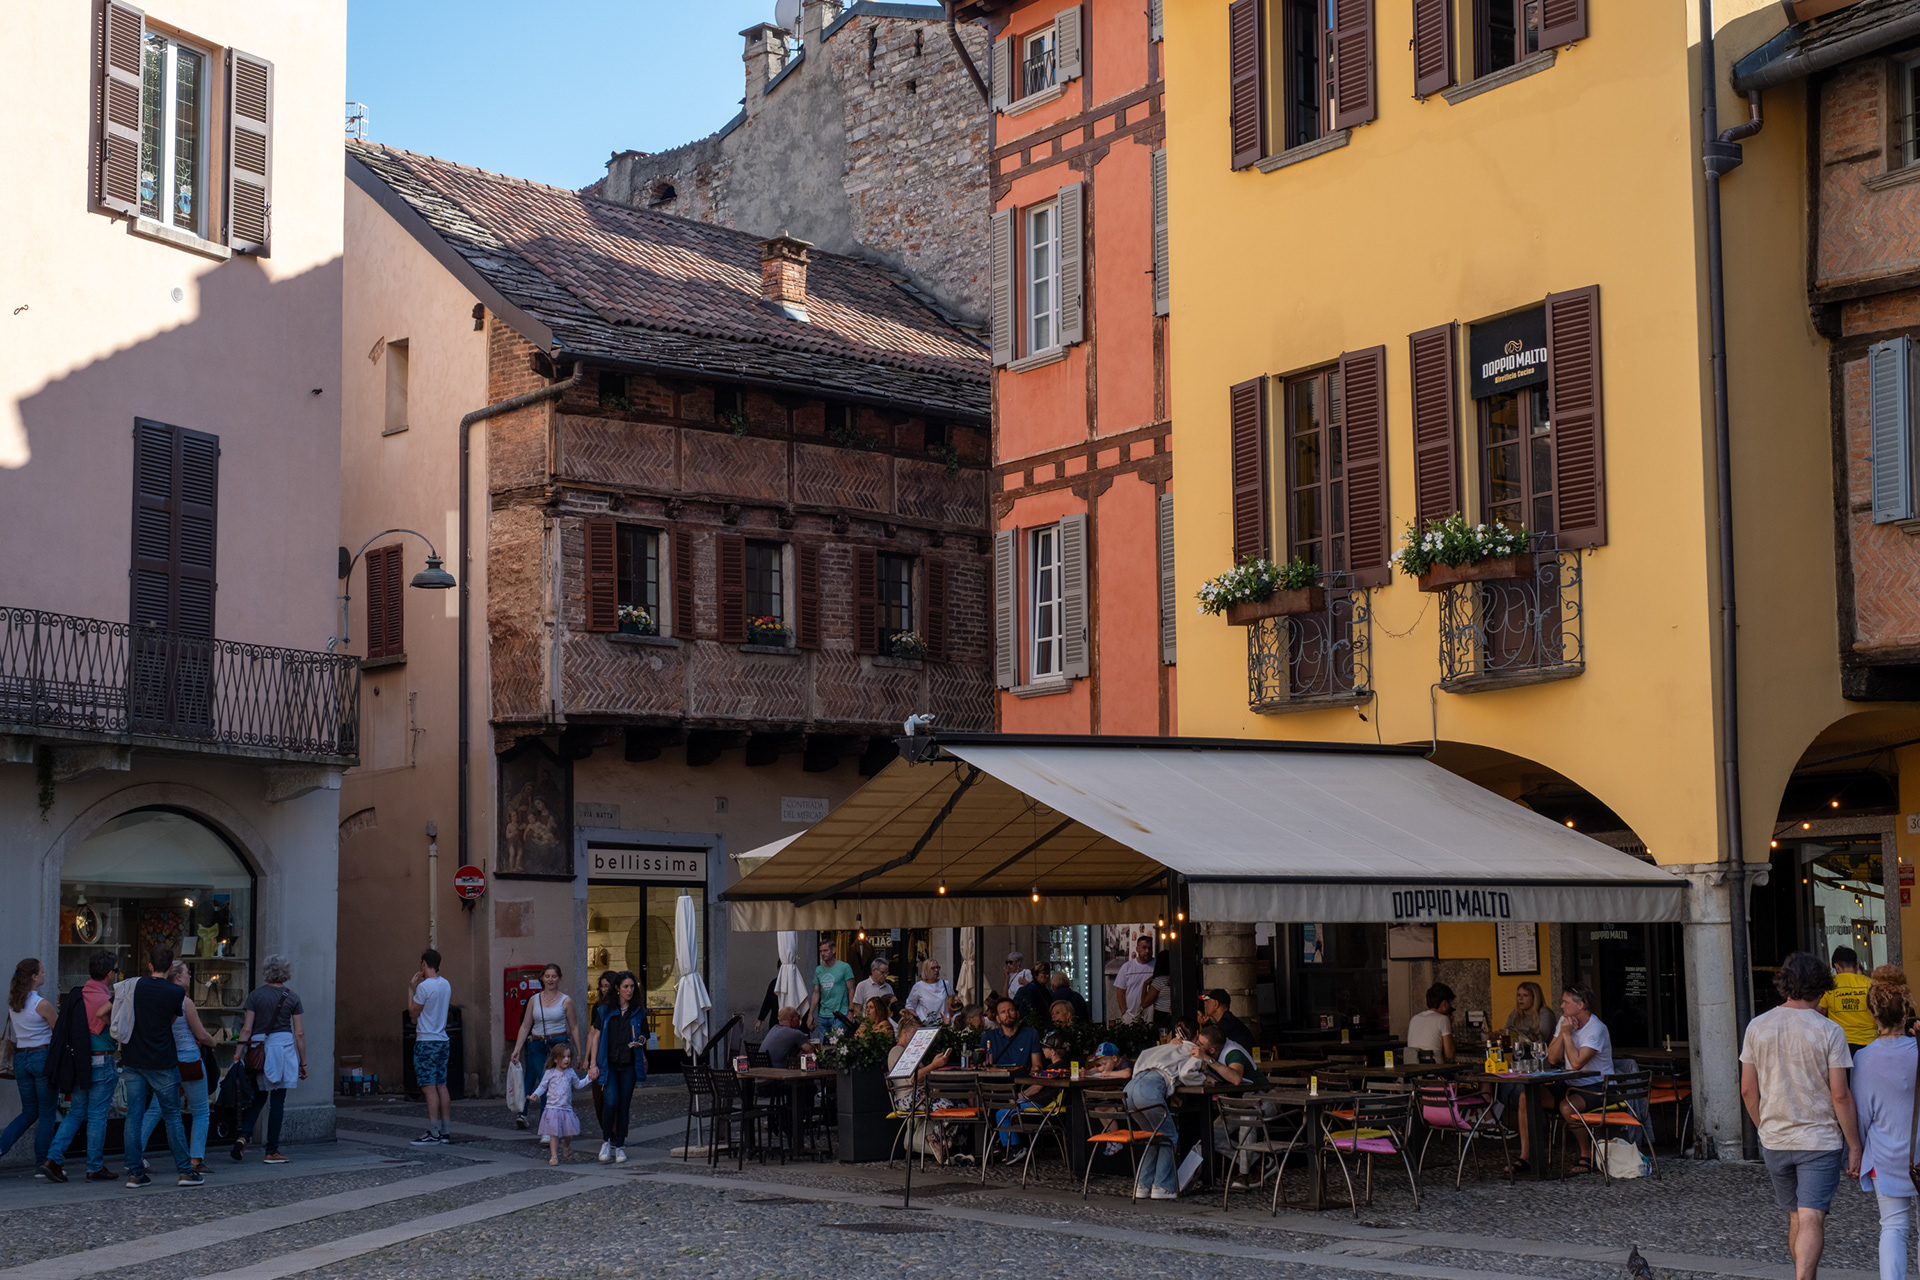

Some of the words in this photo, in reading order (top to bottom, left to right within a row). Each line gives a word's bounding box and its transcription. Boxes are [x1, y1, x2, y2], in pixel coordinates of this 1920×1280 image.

[1482, 354, 1515, 379] DOPPIO
[1516, 347, 1547, 368] MALTO
[1517, 367, 1535, 378] Cucina
[786, 800, 824, 810] CONTRADA
[783, 810, 795, 819] DEL
[595, 854, 697, 872] bellissima
[1392, 889, 1453, 919] DOPPIO
[1456, 889, 1510, 919] MALTO
[1590, 931, 1609, 940] DOPPIO
[1609, 930, 1628, 940] MALTO
